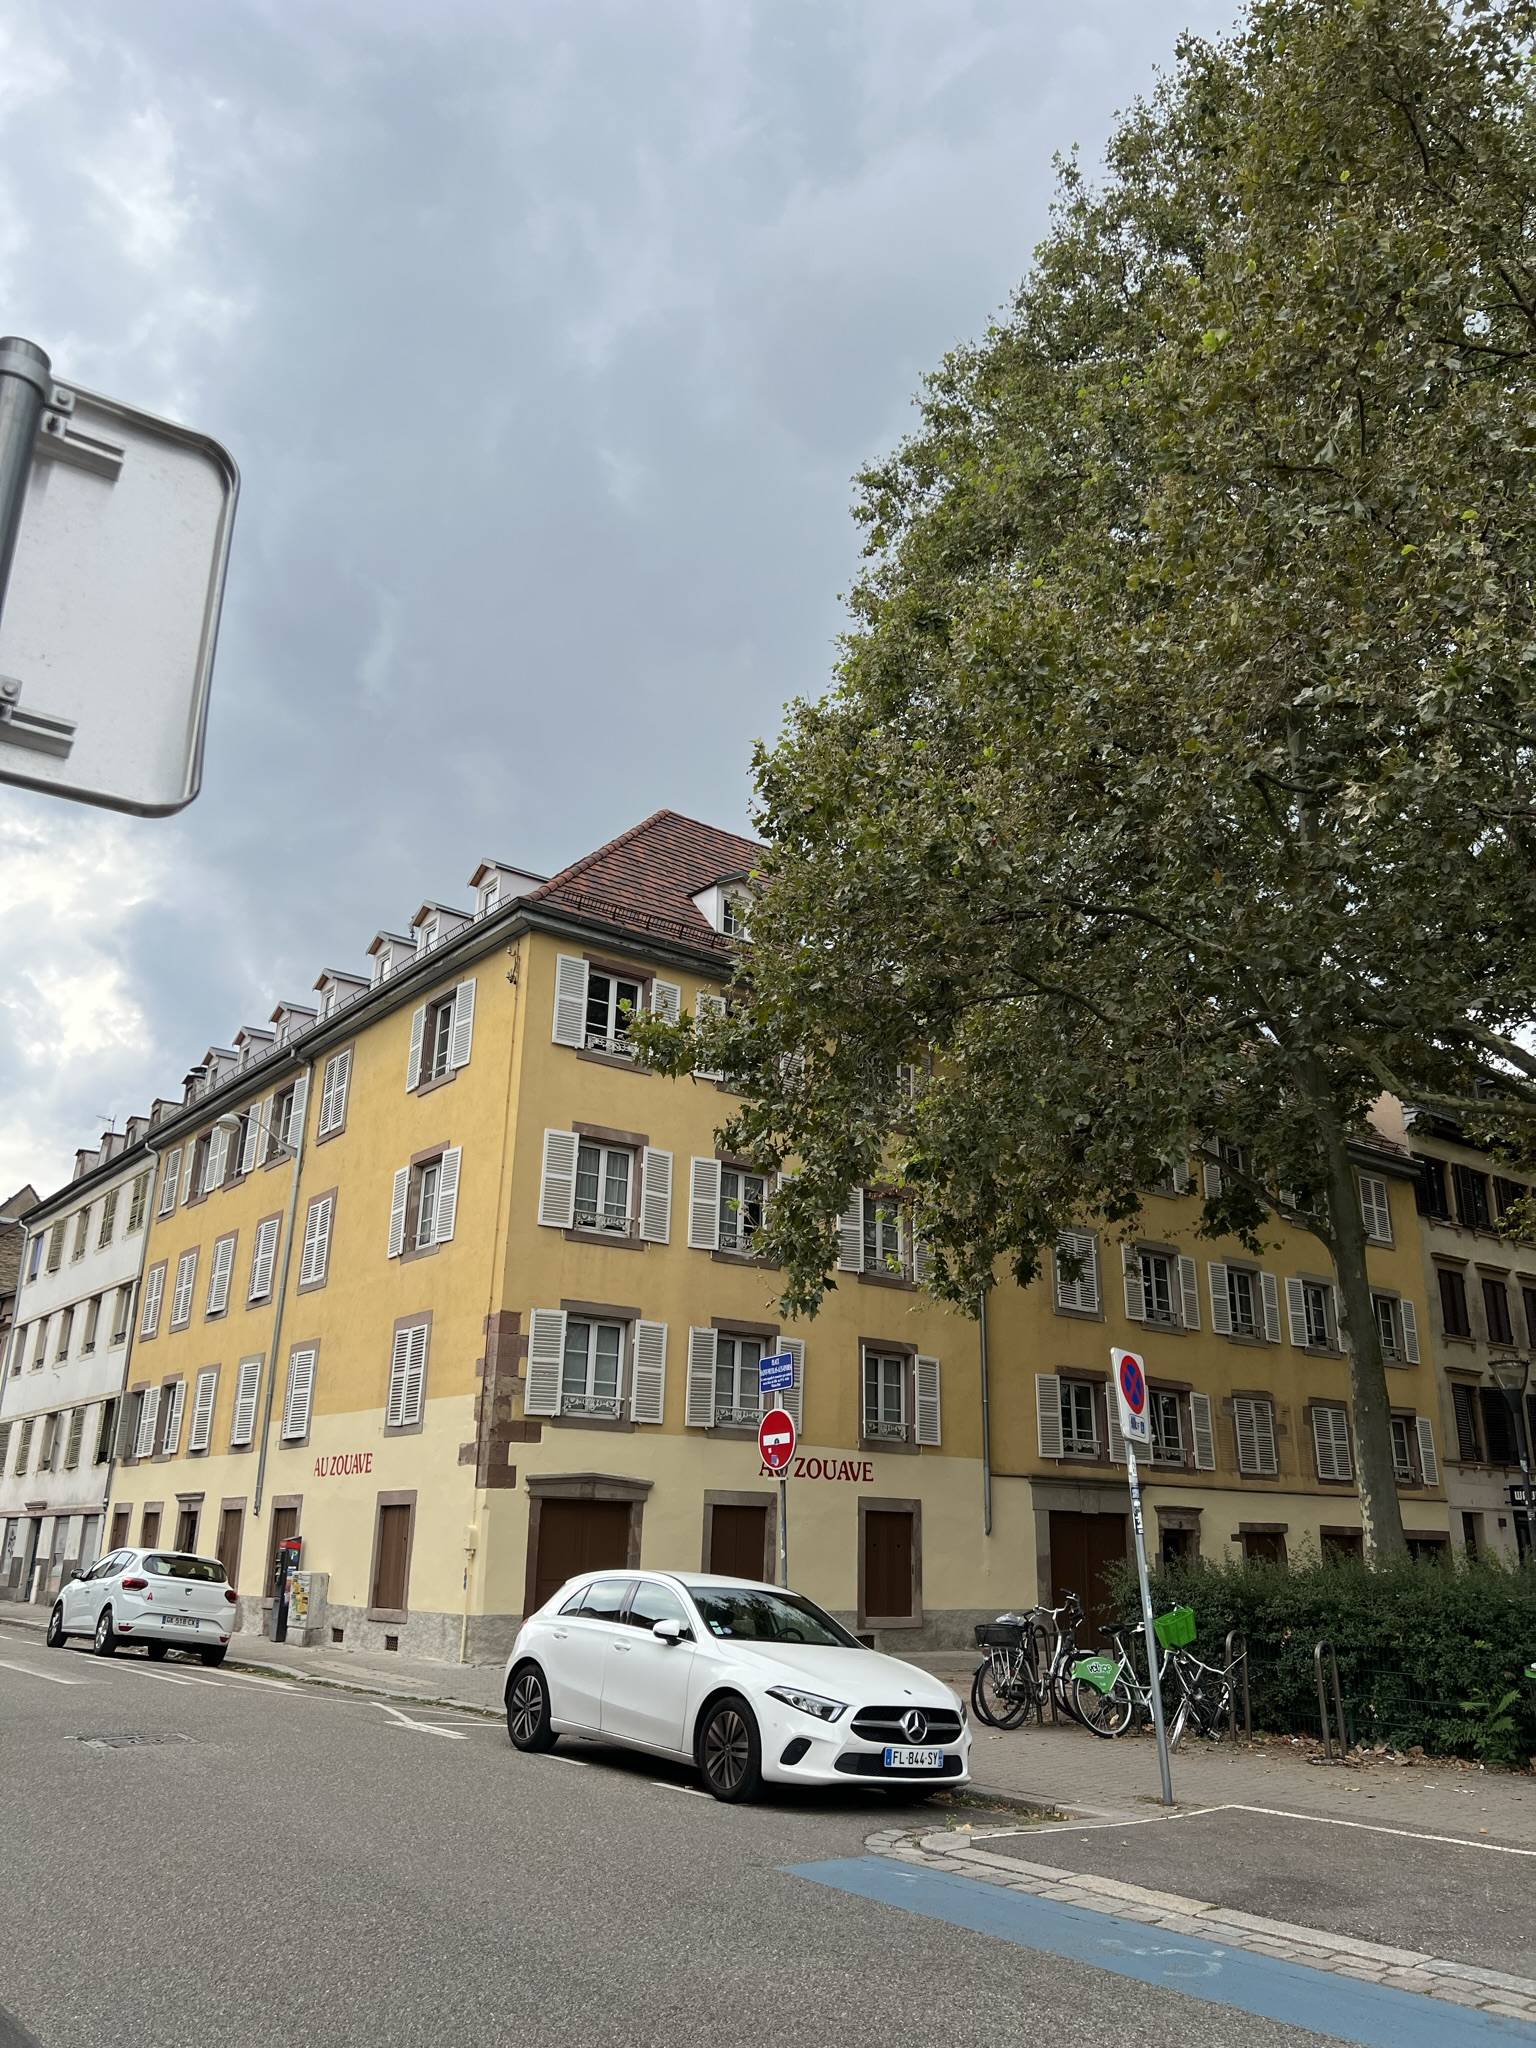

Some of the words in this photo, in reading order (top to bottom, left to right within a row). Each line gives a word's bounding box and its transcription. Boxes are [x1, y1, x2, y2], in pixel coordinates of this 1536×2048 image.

[314, 1457, 329, 1477] AU
[330, 1453, 373, 1476] ZOUAVE
[794, 1458, 874, 1482] ZOUAVE
